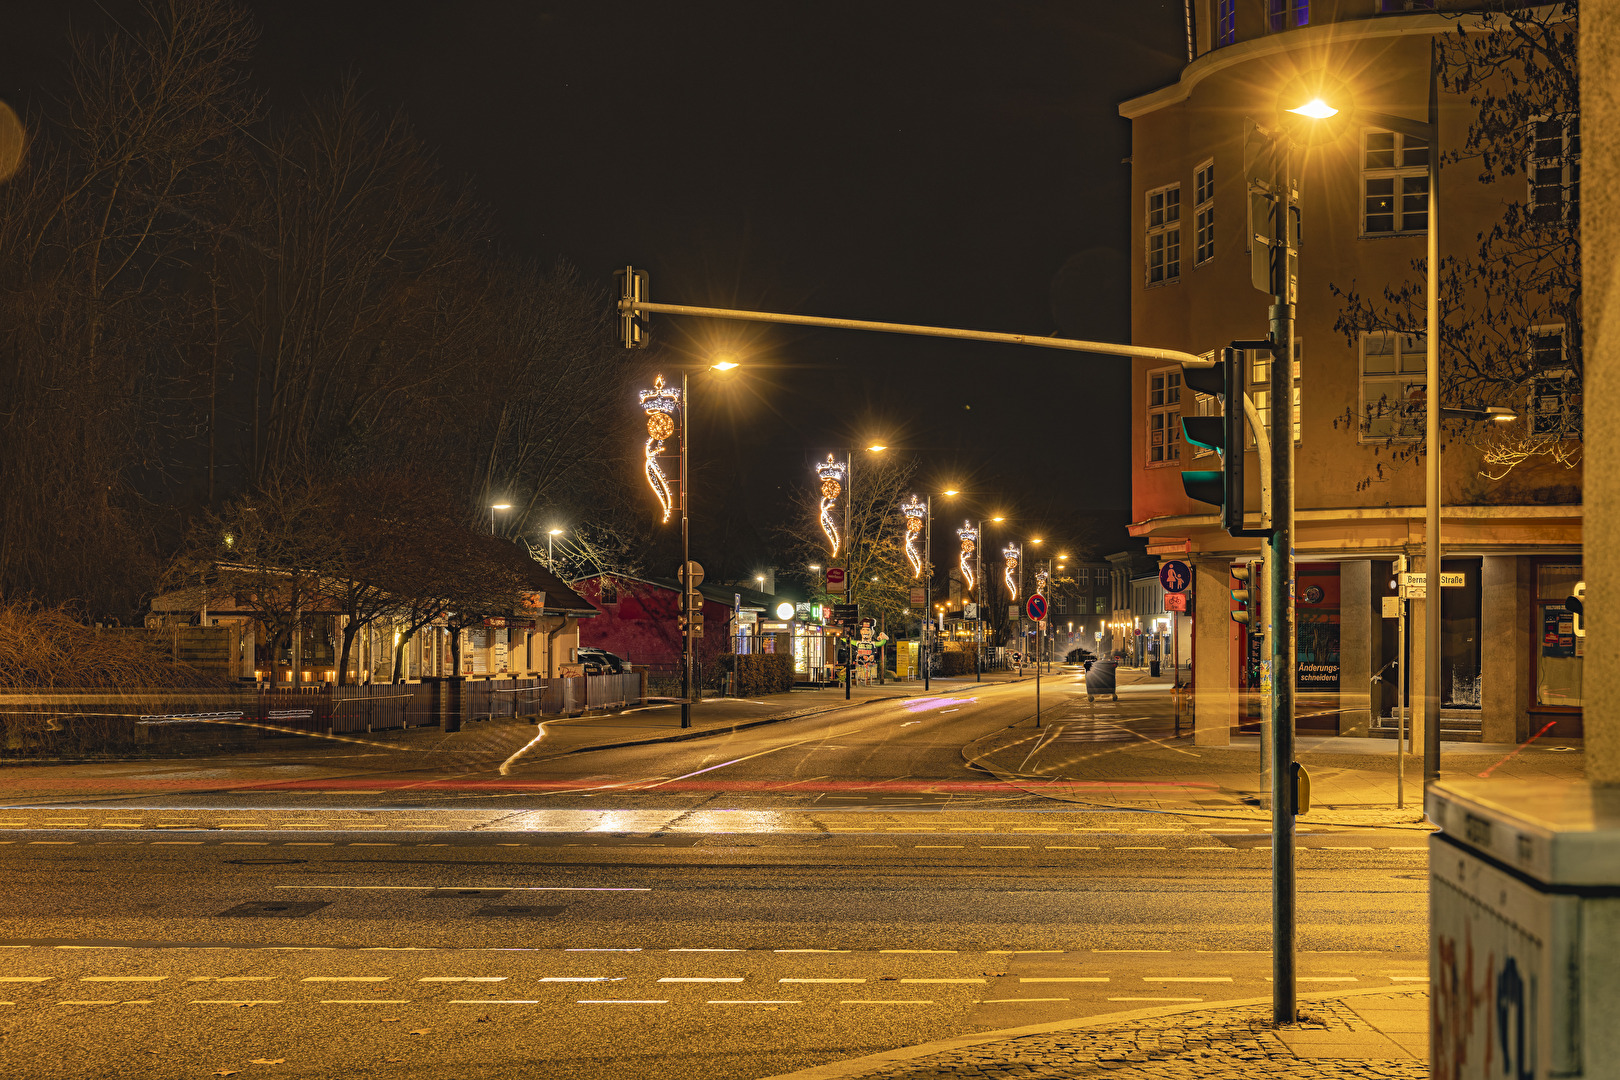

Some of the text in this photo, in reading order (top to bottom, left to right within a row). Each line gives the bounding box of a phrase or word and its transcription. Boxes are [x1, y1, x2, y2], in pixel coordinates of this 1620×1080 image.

[1407, 575, 1463, 584] Berna Straße
[1298, 661, 1340, 673] Änderungs-
